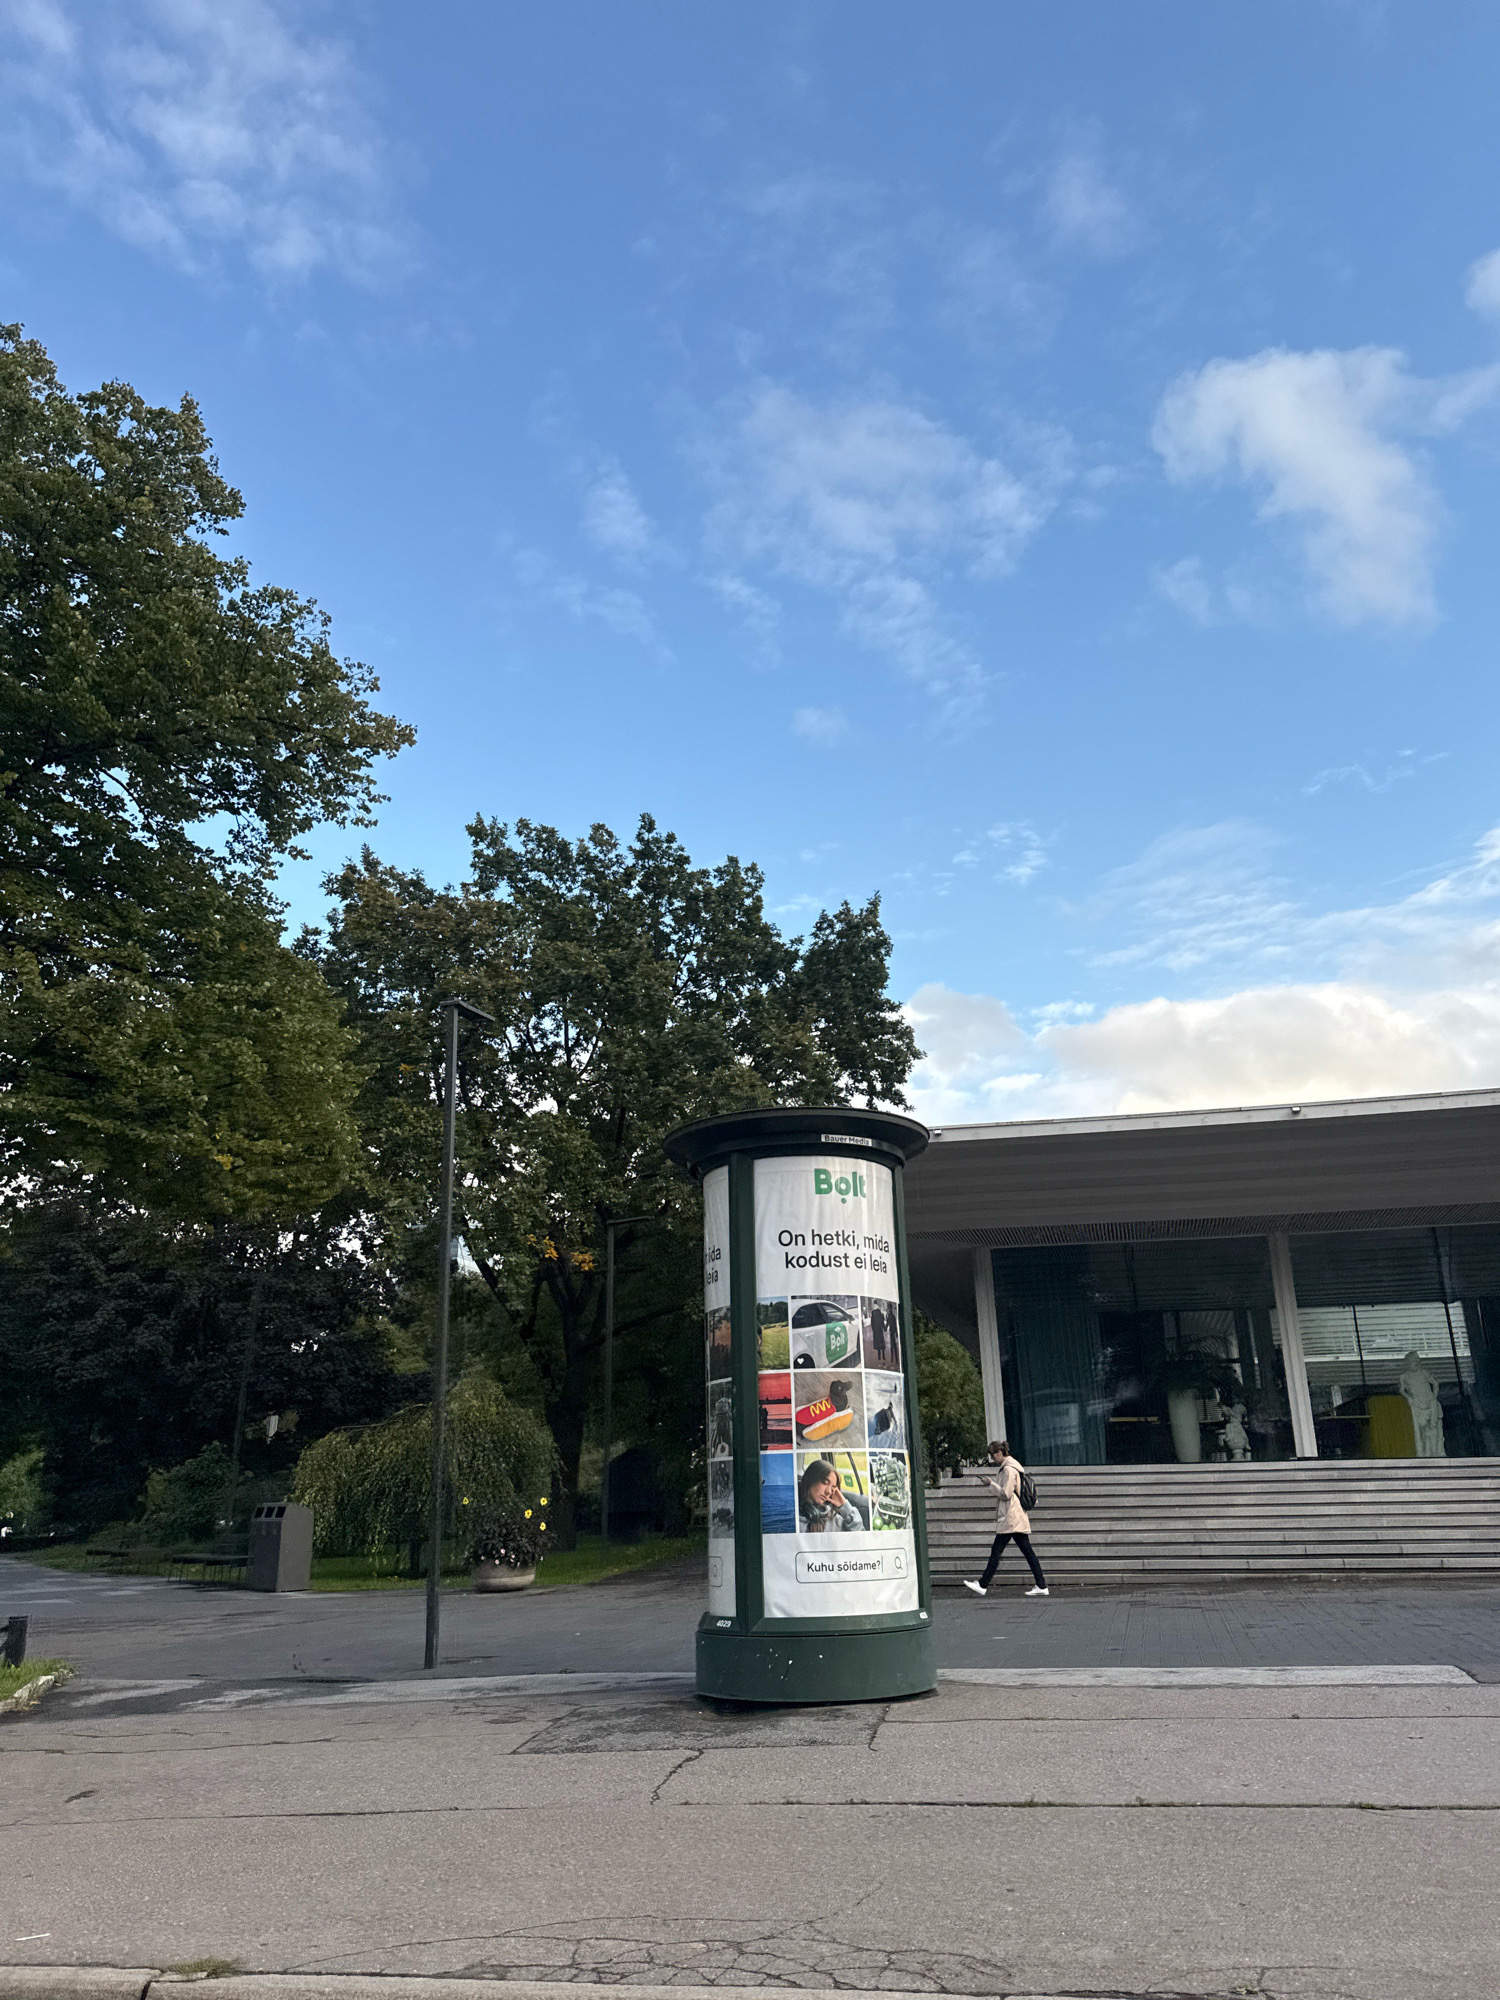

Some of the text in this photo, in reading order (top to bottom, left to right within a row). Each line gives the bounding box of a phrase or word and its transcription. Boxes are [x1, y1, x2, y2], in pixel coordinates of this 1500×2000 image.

[824, 1135, 870, 1146] Bauer Media
[814, 1168, 866, 1204] Bolt
[778, 1229, 889, 1253] On hetki, mida
[785, 1251, 887, 1274] kodust ei leia
[807, 1560, 881, 1572] Kuhu sõidame?
[716, 1620, 732, 1628] 4029
